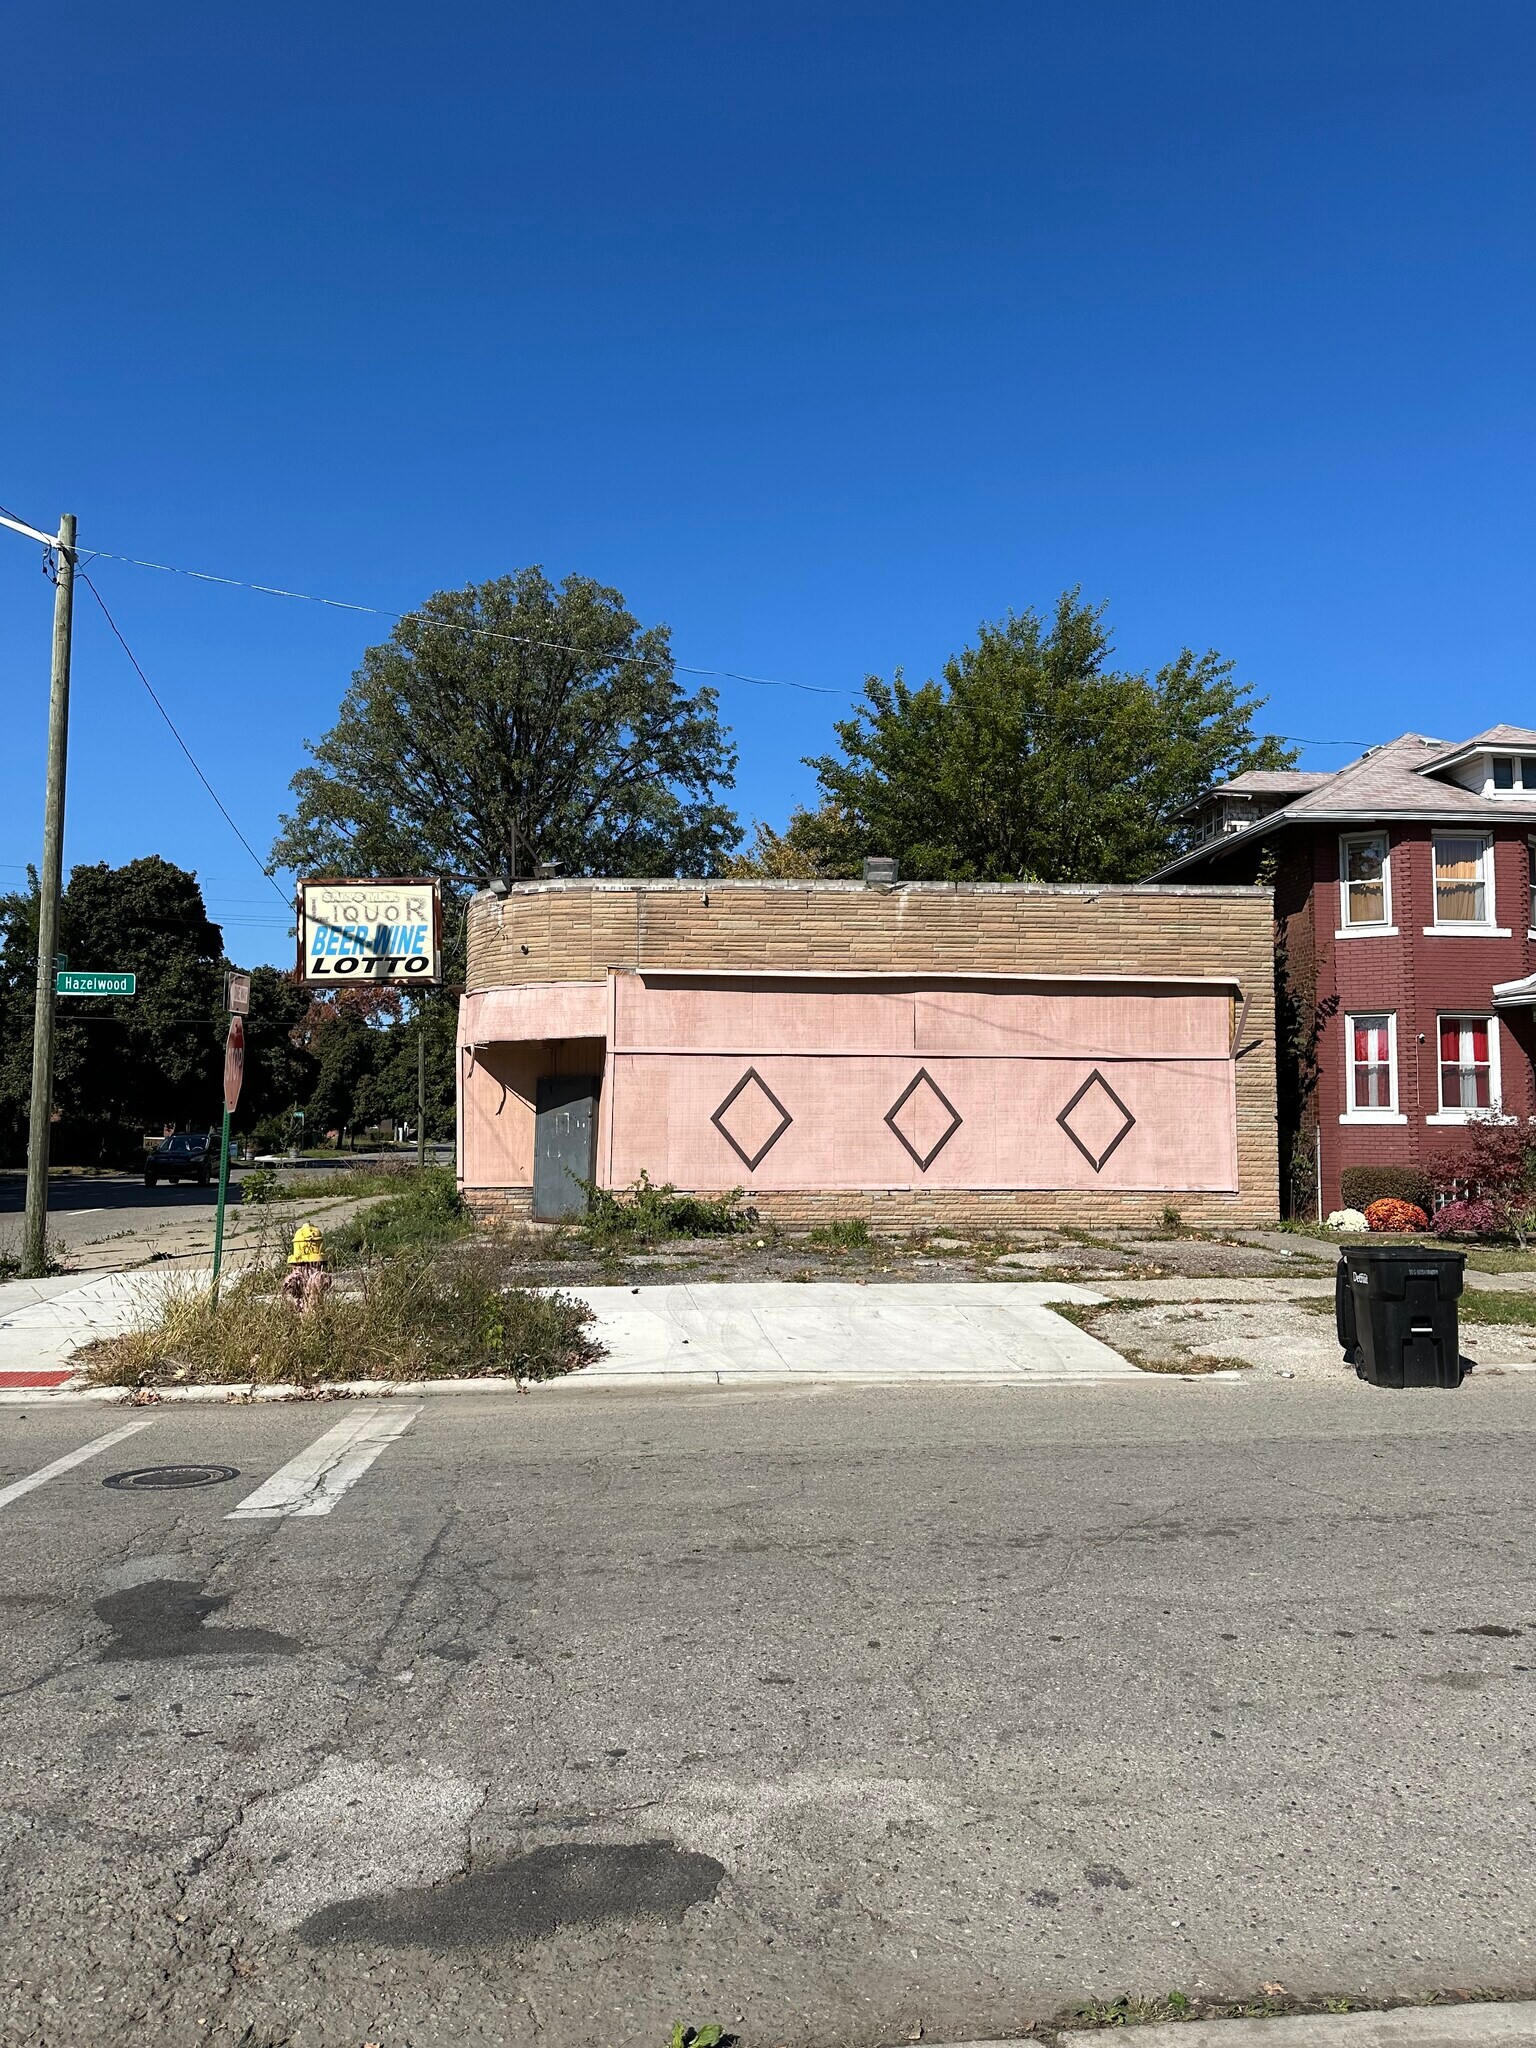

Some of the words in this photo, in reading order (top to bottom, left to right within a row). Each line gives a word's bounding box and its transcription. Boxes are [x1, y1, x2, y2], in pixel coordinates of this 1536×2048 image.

[310, 896, 428, 923] LIQUOR
[311, 924, 428, 956] BEER-WINE
[311, 956, 430, 974] LOTTO
[65, 976, 127, 990] Hazelwood
